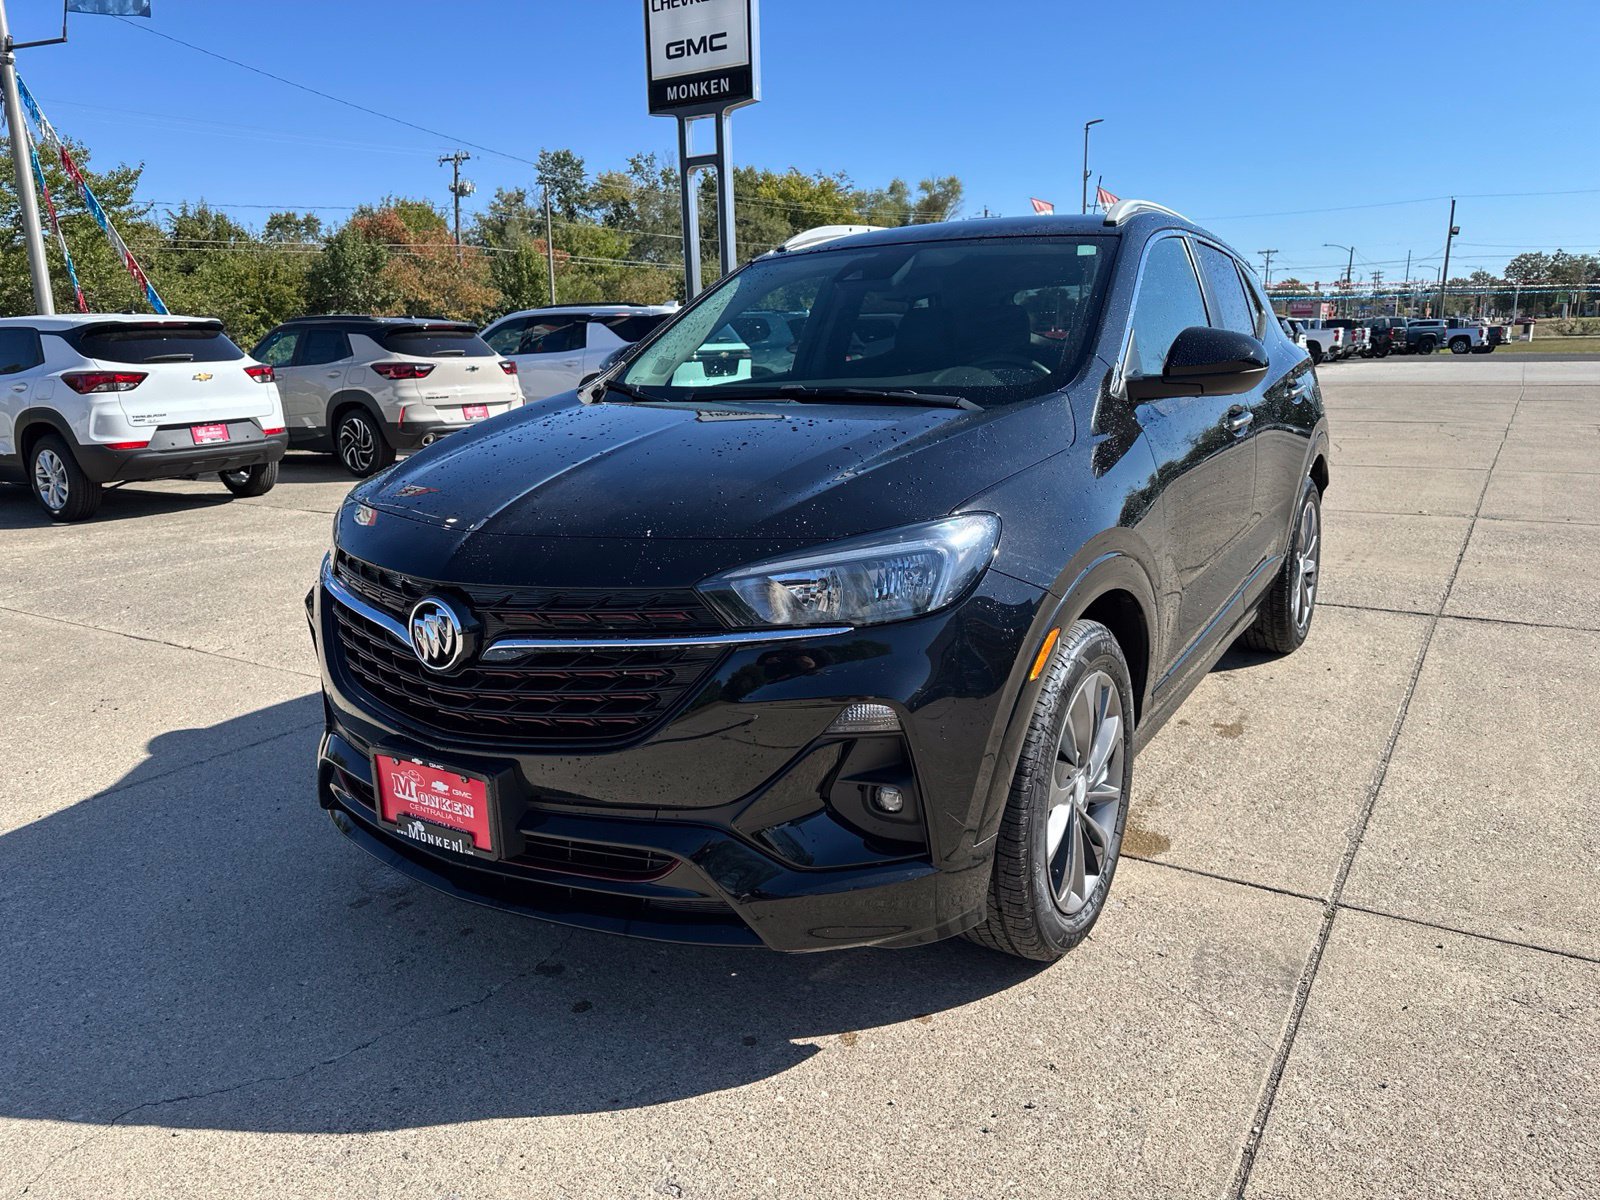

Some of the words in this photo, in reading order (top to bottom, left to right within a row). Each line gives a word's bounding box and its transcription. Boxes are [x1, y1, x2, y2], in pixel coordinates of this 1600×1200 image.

[651, 0, 710, 12] CHE
[665, 31, 728, 60] GMC
[666, 77, 730, 101] MONKEN
[428, 762, 445, 771] GMC
[391, 772, 475, 819] MONKEN
[452, 789, 473, 799] GMC
[457, 816, 464, 824] IL
